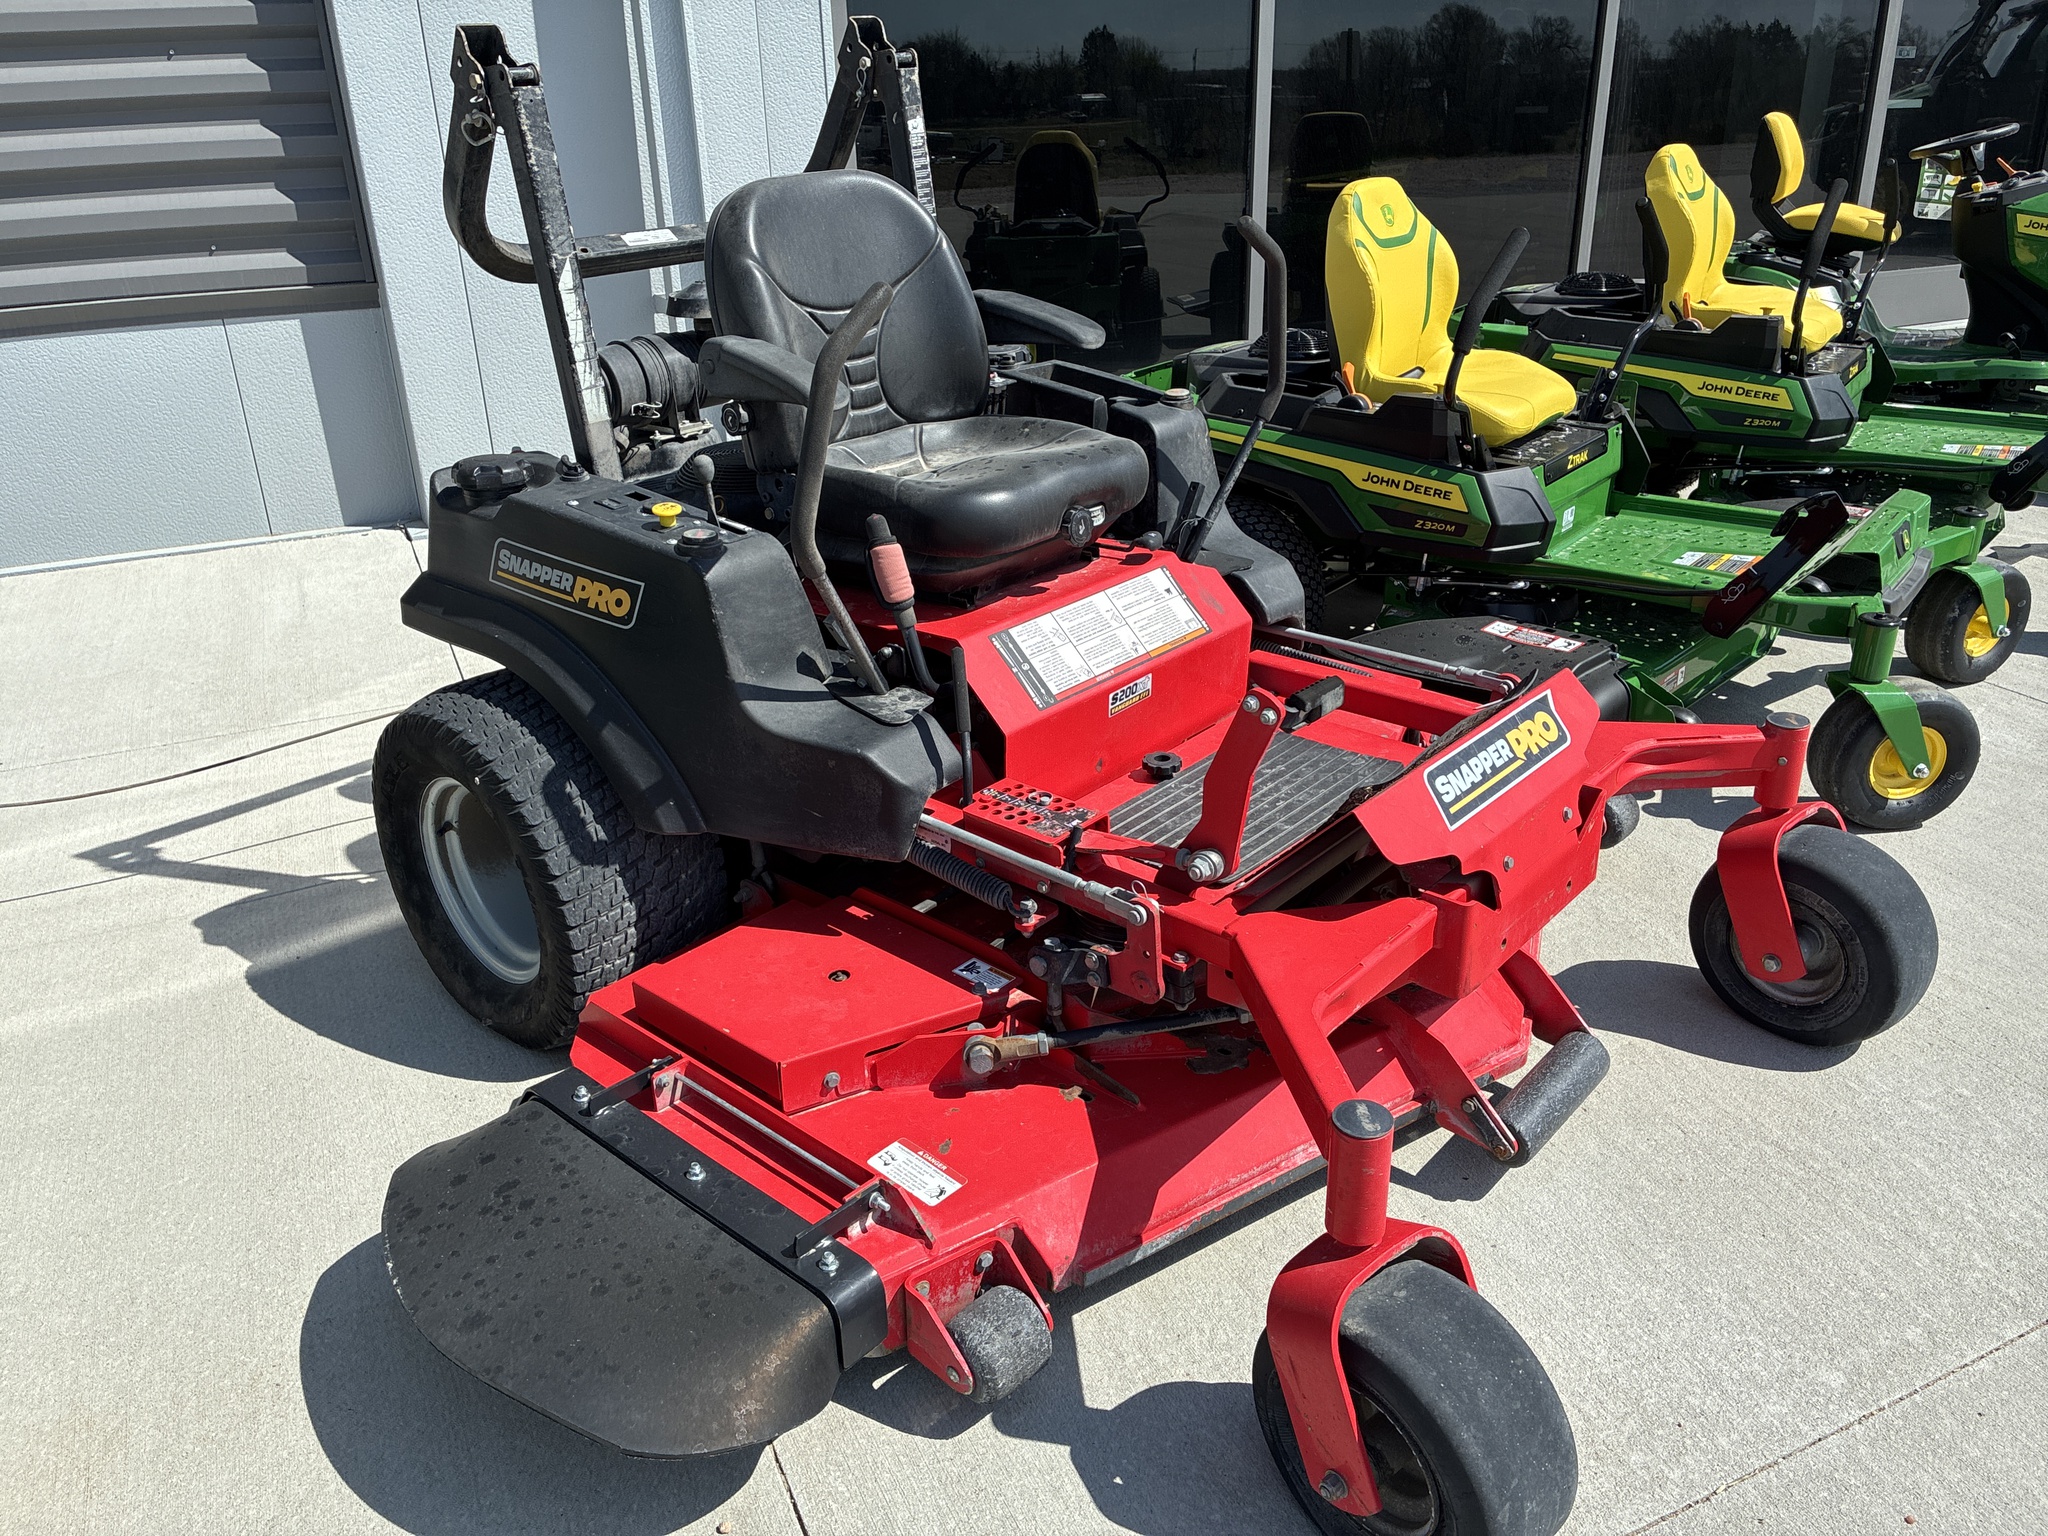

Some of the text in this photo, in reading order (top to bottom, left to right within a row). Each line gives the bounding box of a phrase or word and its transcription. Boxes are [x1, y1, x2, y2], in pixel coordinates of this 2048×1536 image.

[1697, 381, 1780, 402] JOHN DEERE
[1362, 471, 1453, 501] JOHN DEERE
[1414, 519, 1456, 533] Z320M
[498, 548, 632, 617] SNAPPER PRO
[1434, 711, 1559, 804] SNAPPER PRO
[923, 1153, 948, 1171] DANGER
